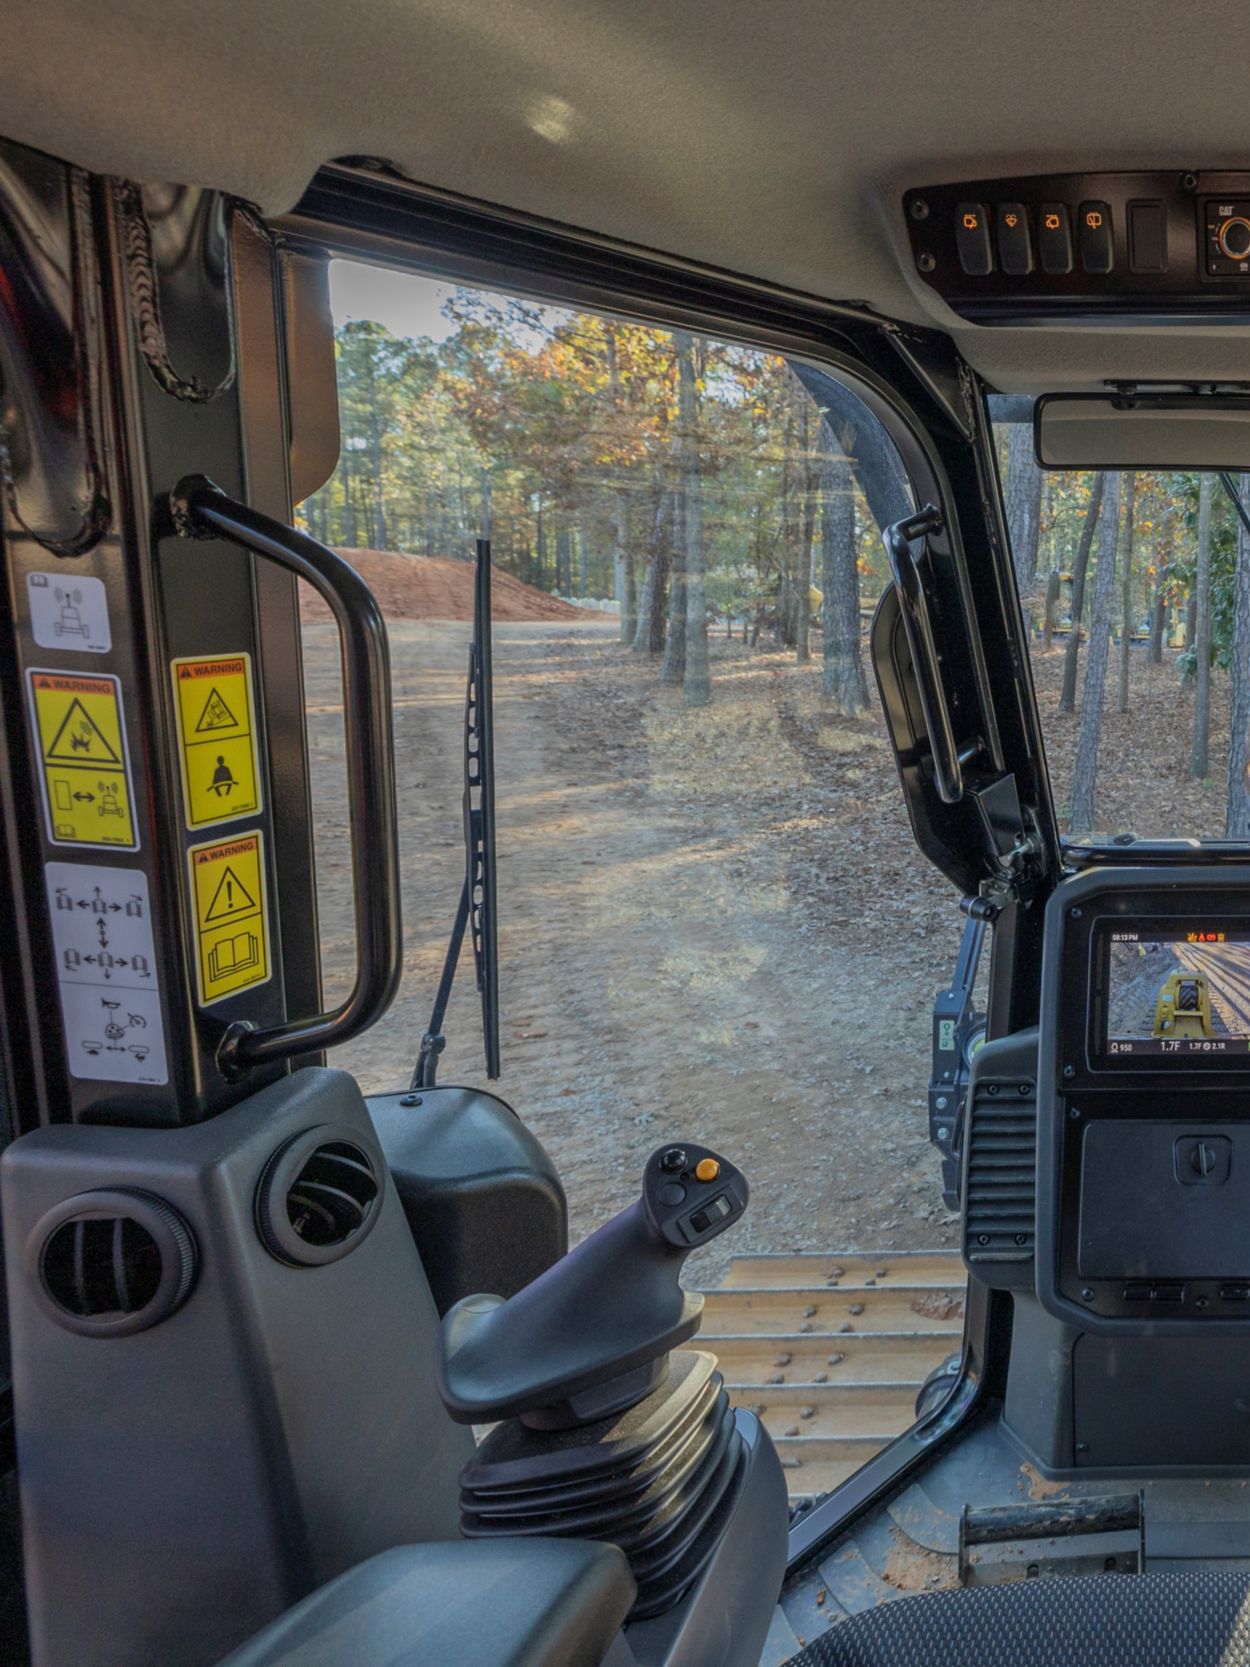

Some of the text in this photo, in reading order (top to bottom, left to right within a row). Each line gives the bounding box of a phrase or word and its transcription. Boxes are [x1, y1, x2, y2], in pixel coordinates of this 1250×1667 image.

[1219, 206, 1234, 216] CAT
[193, 663, 242, 676] WARNING
[53, 679, 112, 694] WARNING
[210, 841, 254, 860] WARNING
[1120, 1043, 1133, 1052] 950
[1161, 1041, 1181, 1052] 1.7F
[1189, 1042, 1202, 1050] 1.7F
